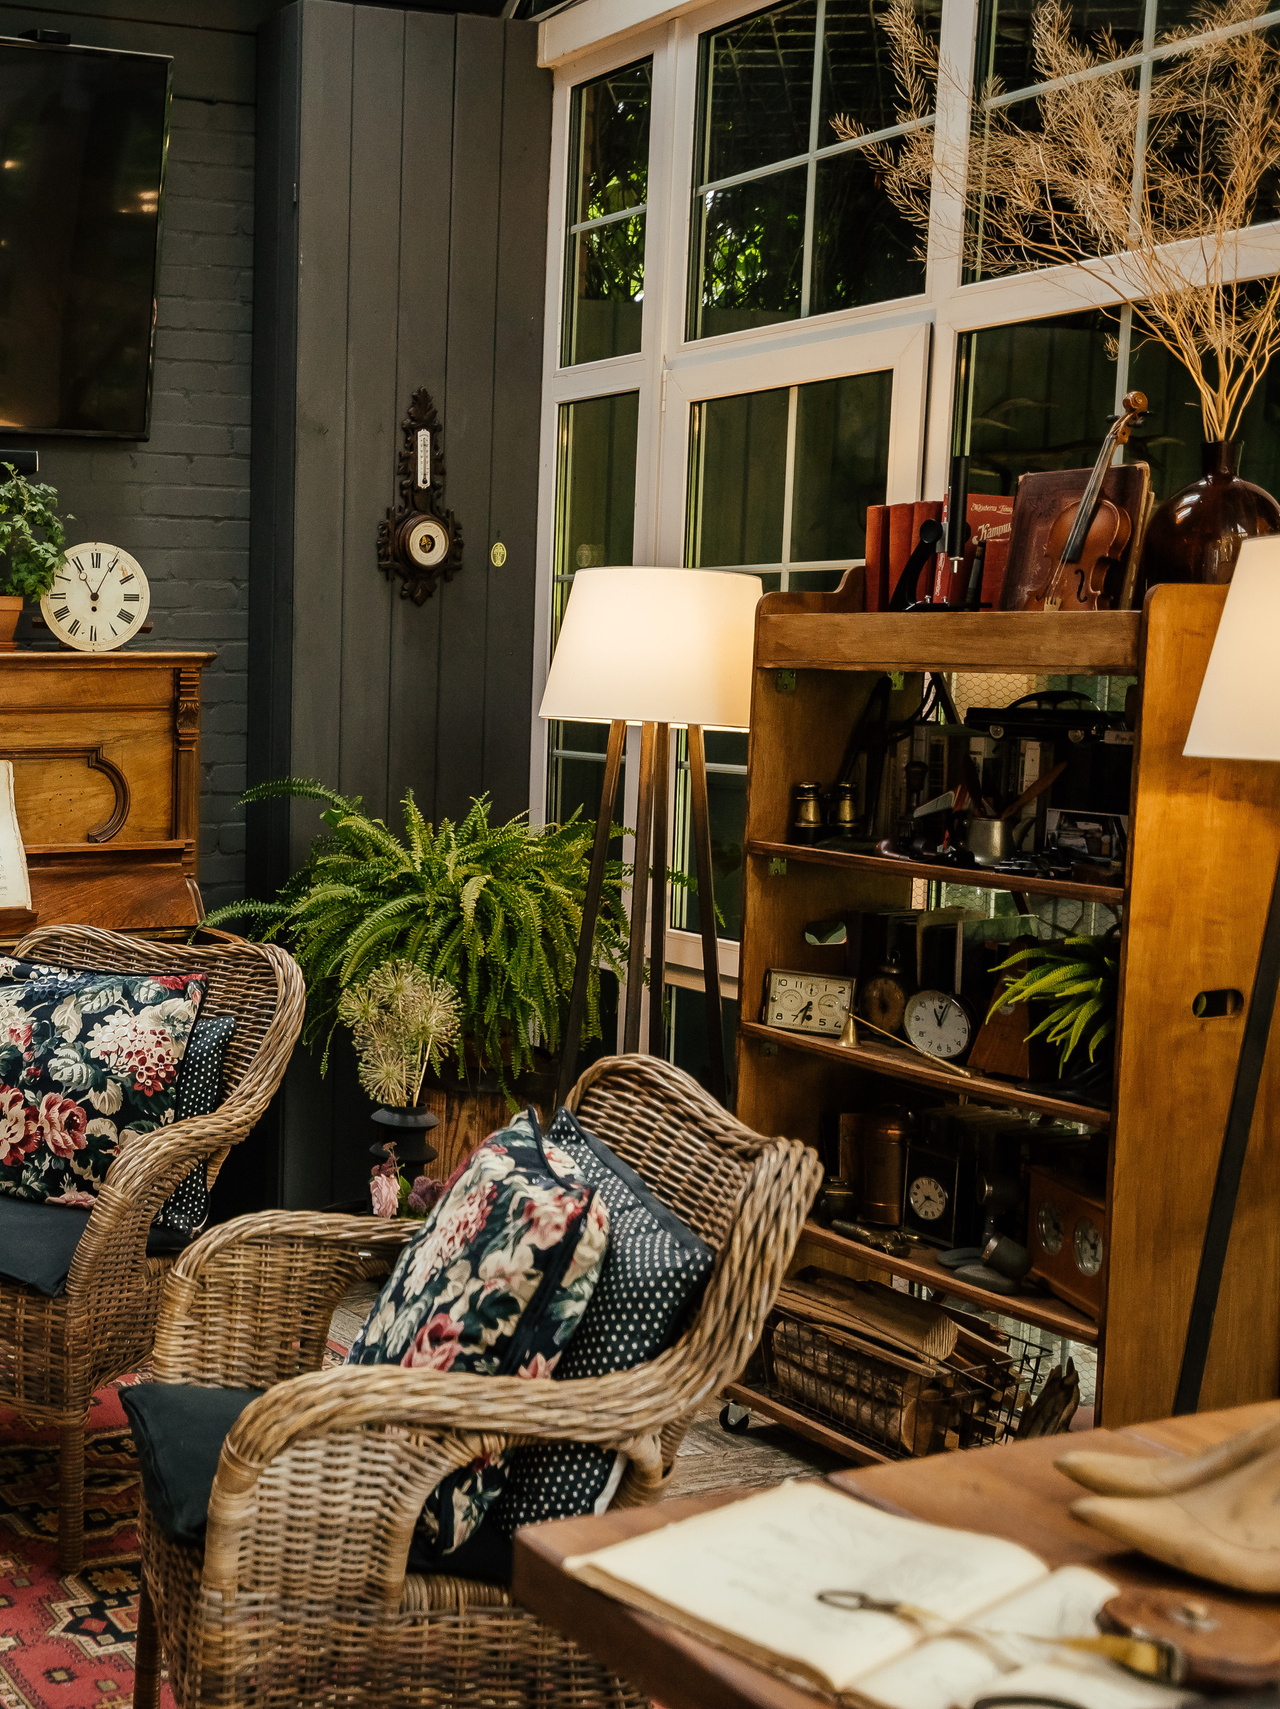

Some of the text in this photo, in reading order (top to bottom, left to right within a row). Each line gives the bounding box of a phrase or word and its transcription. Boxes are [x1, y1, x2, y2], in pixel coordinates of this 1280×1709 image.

[778, 978, 787, 987] 10
[795, 981, 803, 989] 11
[837, 986, 846, 994] 2
[775, 1012, 783, 1020] 8
[818, 1018, 827, 1026] 5
